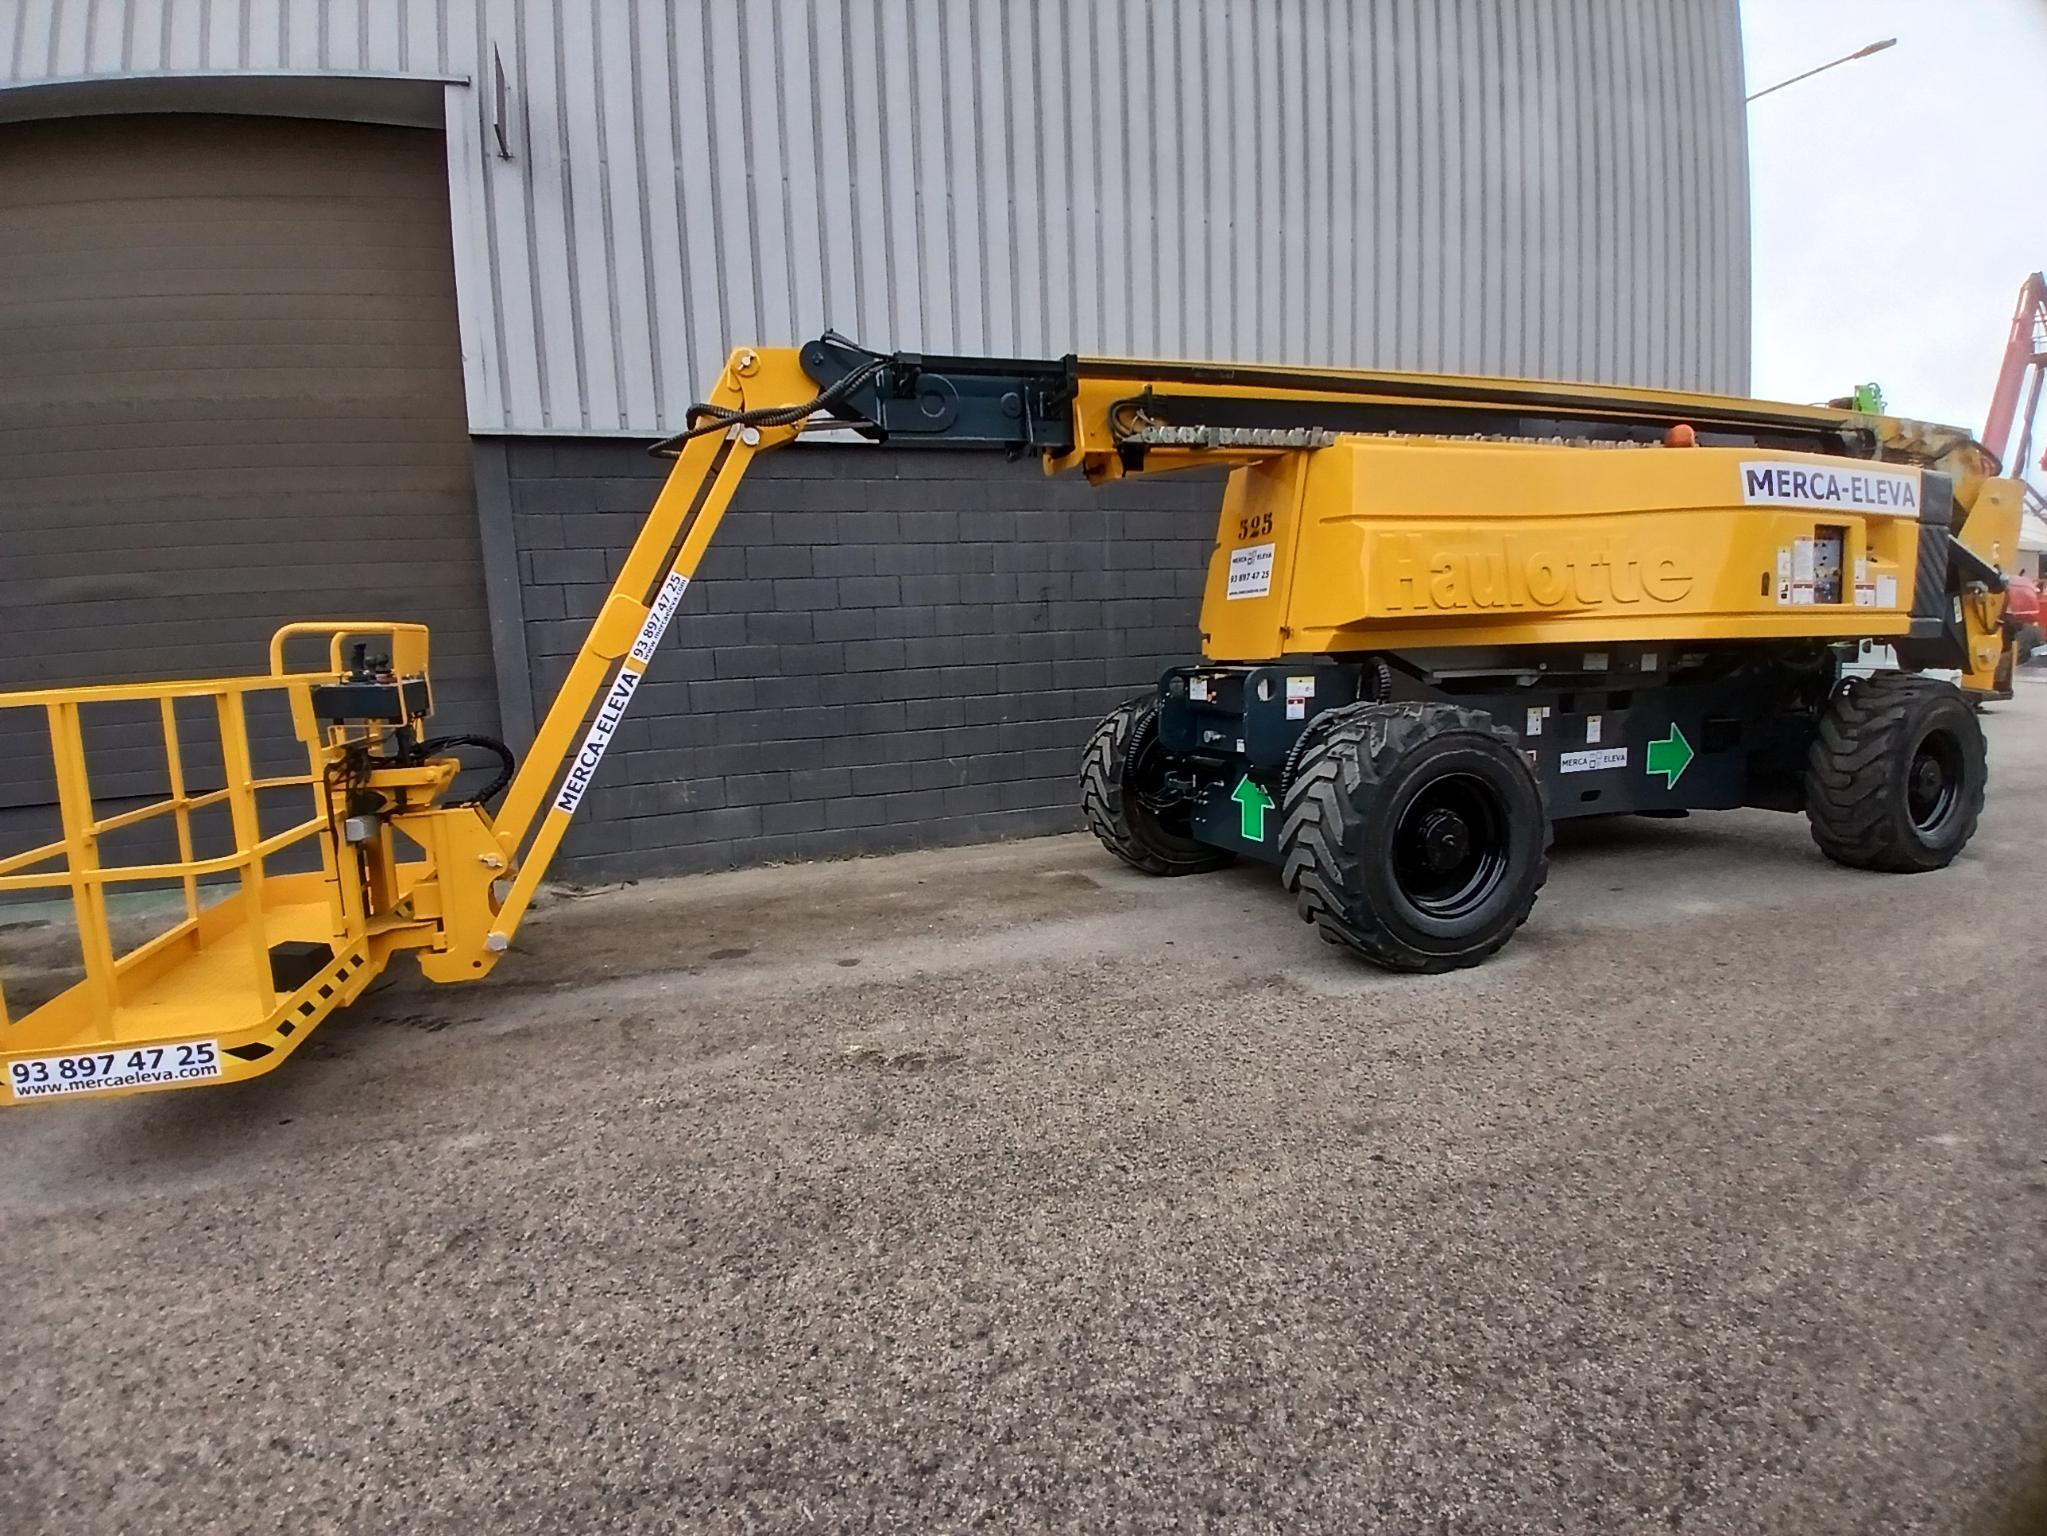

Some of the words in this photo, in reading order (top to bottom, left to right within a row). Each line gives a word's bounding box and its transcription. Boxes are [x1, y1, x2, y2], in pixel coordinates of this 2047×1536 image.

[1746, 469, 1916, 508] MERCA-ELEVA
[1238, 512, 1273, 540] 525
[1261, 570, 1270, 579] 25
[1378, 529, 1694, 610] Haulotte
[633, 640, 648, 658] 93
[643, 613, 661, 639] 897
[657, 594, 670, 612] 47
[666, 575, 681, 592] 25
[558, 673, 638, 811] MERCA-ELEVA
[1562, 758, 1588, 767] MERCA
[1603, 754, 1626, 763] ELEVA
[12, 1062, 49, 1084] 93
[58, 1055, 115, 1080] 897
[127, 1049, 164, 1072] 47
[176, 1042, 216, 1067] 25
[16, 1064, 218, 1096] www.mercaeleva.com
